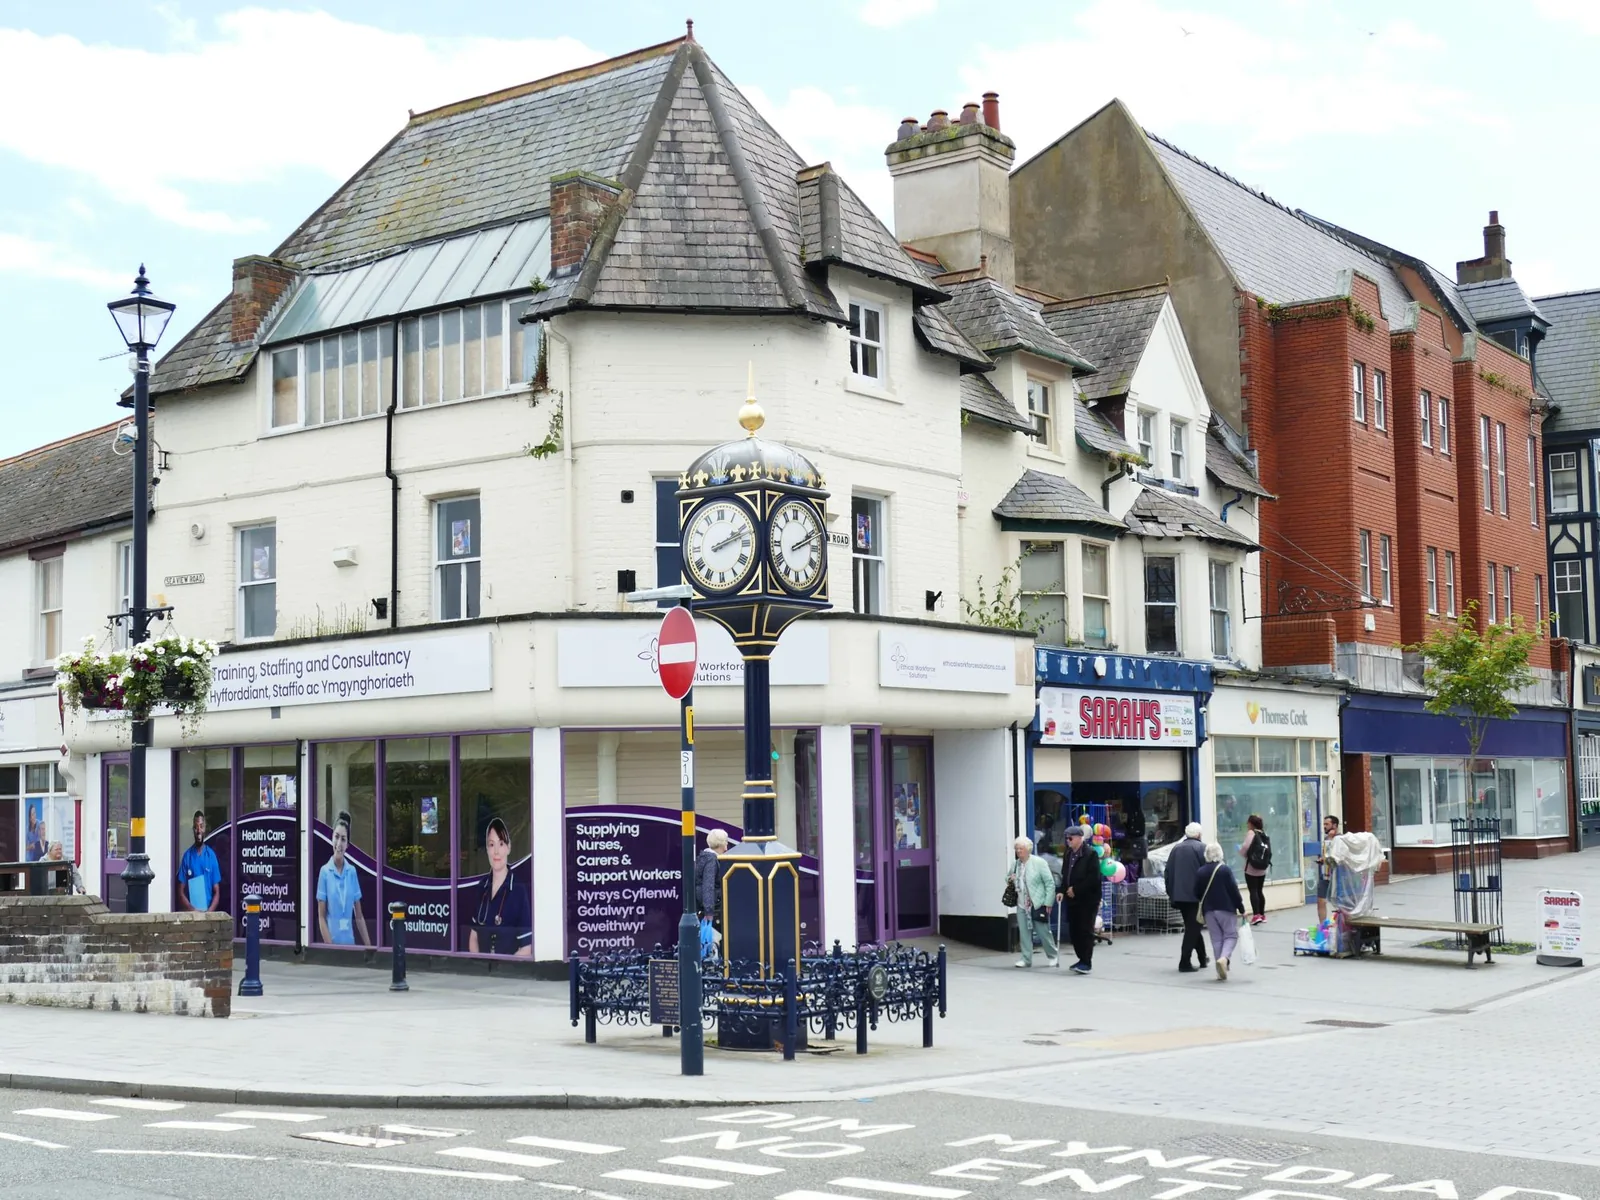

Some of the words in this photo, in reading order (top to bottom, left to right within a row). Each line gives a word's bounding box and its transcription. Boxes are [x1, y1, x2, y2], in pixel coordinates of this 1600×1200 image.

[832, 534, 848, 544] ROAD
[212, 663, 258, 683] Training,
[260, 658, 303, 678] Staffing
[306, 655, 329, 672] and
[332, 650, 411, 670] Consultancy
[700, 662, 746, 670] Workforc
[692, 672, 731, 681] lutions
[210, 685, 270, 706] Hyfforddiant,
[272, 681, 304, 698] Staffio
[306, 683, 320, 694] ac
[322, 672, 414, 697] Ymgynghoriaeth
[1080, 696, 1162, 740] SARAH'S
[1260, 707, 1289, 724] Thomas
[1290, 709, 1308, 726] Cook
[242, 829, 266, 841] Health
[267, 829, 286, 841] Care
[576, 822, 640, 838] Supplying
[242, 845, 258, 857] and
[258, 844, 286, 858] Clinical
[576, 840, 623, 851] Nurses,
[576, 856, 620, 866] Carers
[621, 854, 632, 866] &
[242, 861, 272, 878] Training
[577, 871, 628, 885] Support
[629, 868, 682, 880] Workers
[242, 882, 262, 895] Gofal
[262, 882, 288, 899] Iechyd
[578, 890, 620, 904] Nyrsys
[622, 886, 680, 903] Cyflenwi,
[1544, 896, 1580, 907] SARAH'S
[408, 902, 426, 915] and
[428, 904, 450, 918] CQC
[578, 904, 634, 919] Gofalwyr
[636, 906, 646, 915] a
[578, 920, 646, 934] Gweithwyr
[578, 936, 635, 952] Cymorth
[696, 1109, 915, 1138] DIM
[660, 1130, 865, 1158] NO
